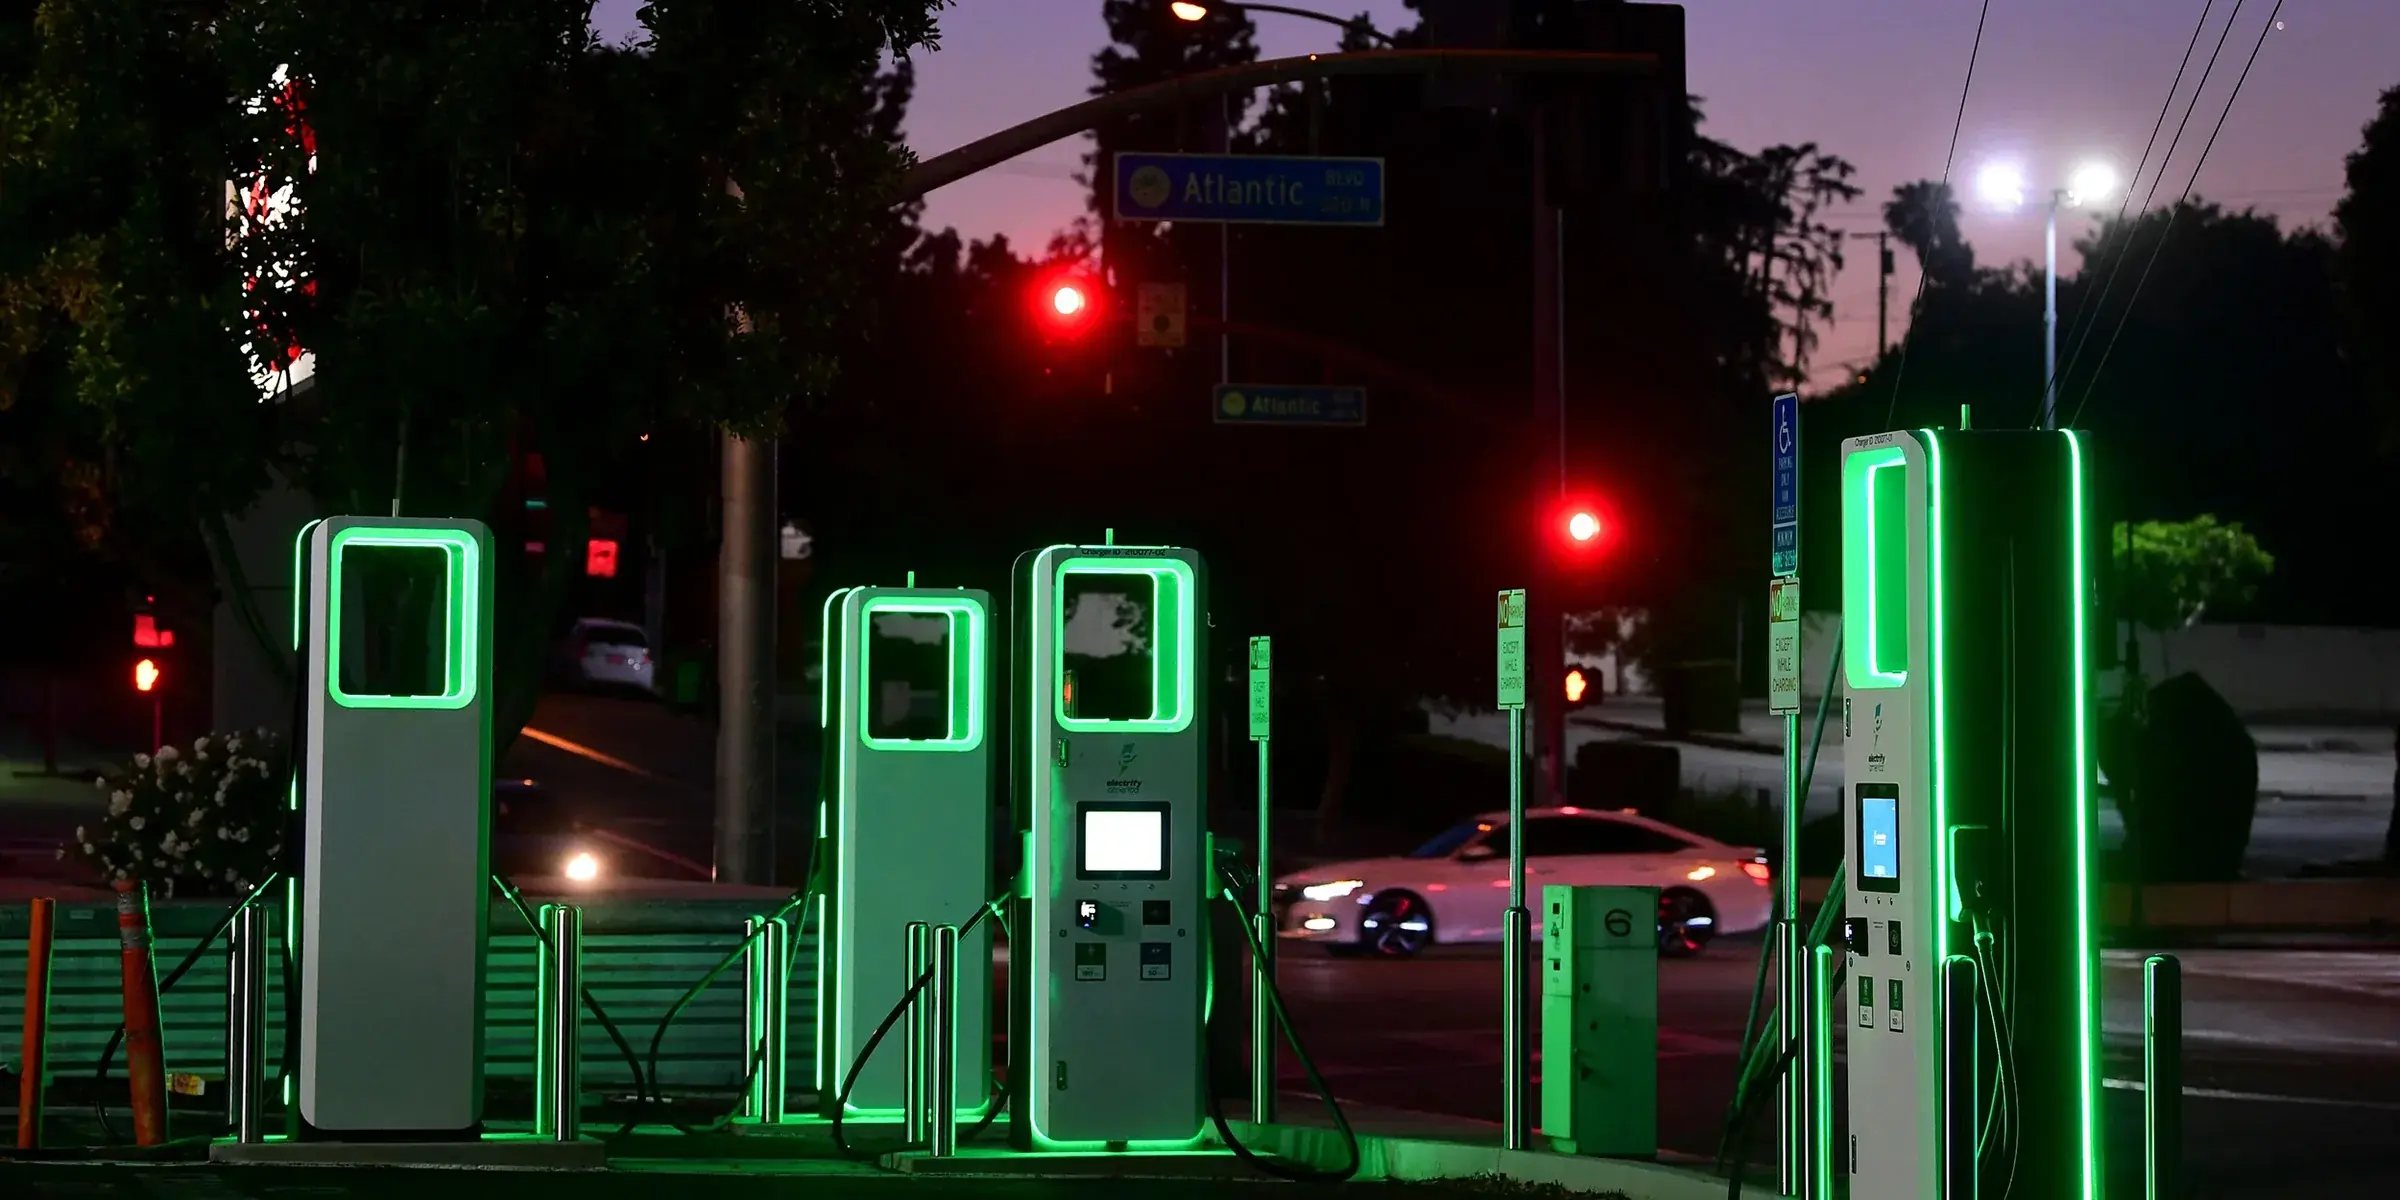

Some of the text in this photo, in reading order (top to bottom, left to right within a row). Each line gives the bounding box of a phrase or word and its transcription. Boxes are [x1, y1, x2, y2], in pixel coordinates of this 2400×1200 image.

[1183, 171, 1305, 207] Atlantic
[1252, 394, 1321, 416] Atlantic
[1772, 590, 1782, 617] NO
[1775, 636, 1793, 652] EXCEPT
[1777, 657, 1791, 672] WHILE
[1772, 677, 1796, 693] CHARGING
[1106, 777, 1143, 788] electrify
[1604, 908, 1632, 937] 6
